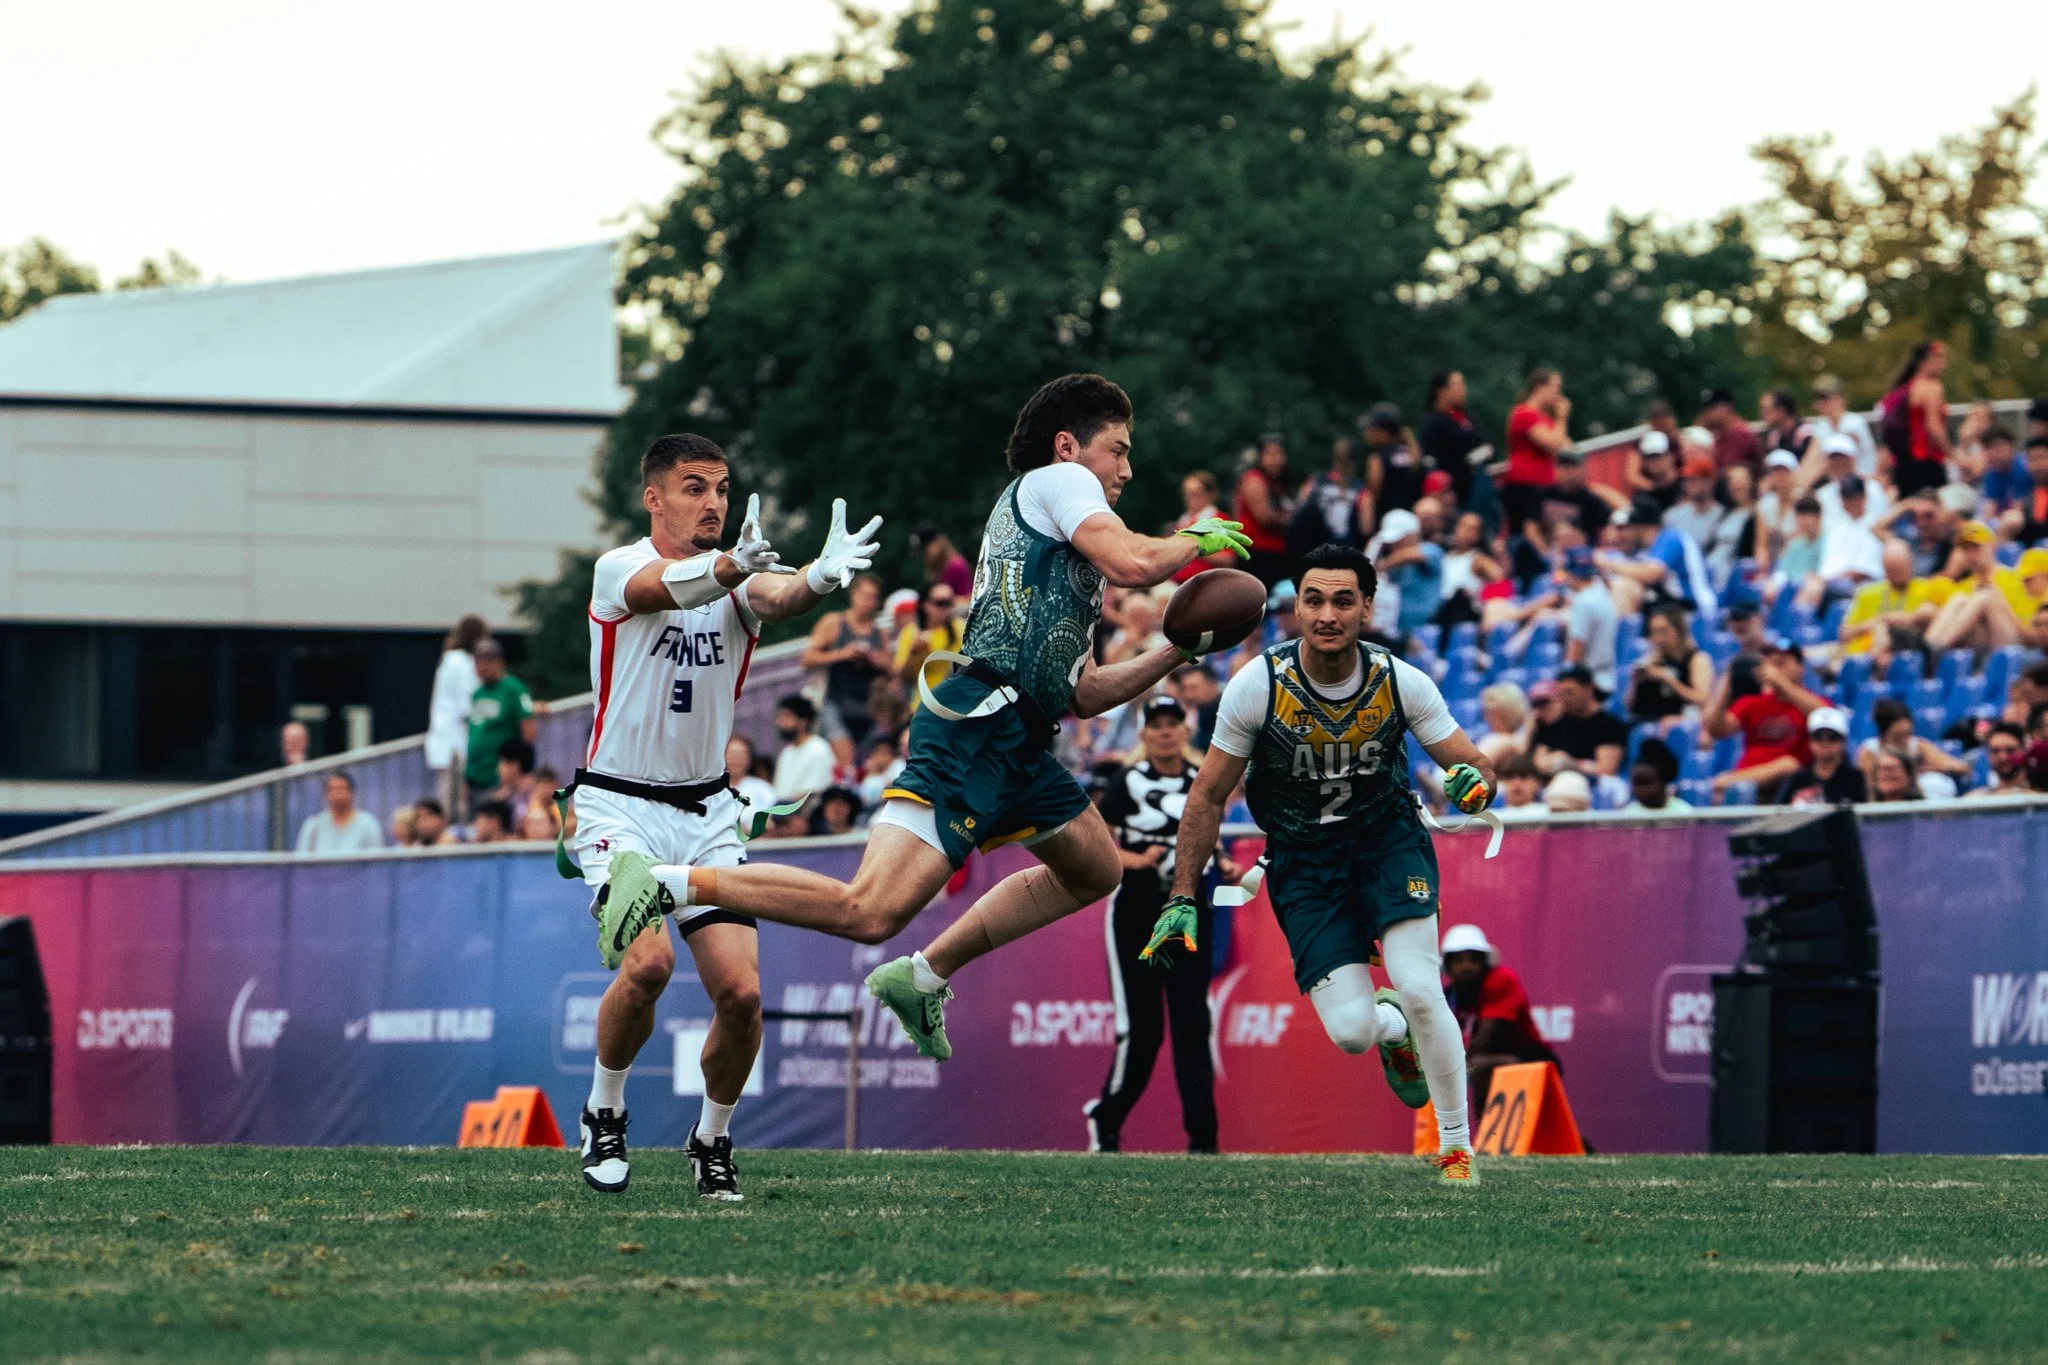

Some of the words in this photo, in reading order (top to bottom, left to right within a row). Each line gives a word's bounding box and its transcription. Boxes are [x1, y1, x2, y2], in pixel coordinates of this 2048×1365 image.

[1292, 712, 1315, 727] AFA
[1291, 740, 1383, 780] AUS
[1319, 779, 1353, 824] 2
[1009, 1001, 1117, 1047] D.SPORT
[1477, 1088, 1527, 1154] 20
